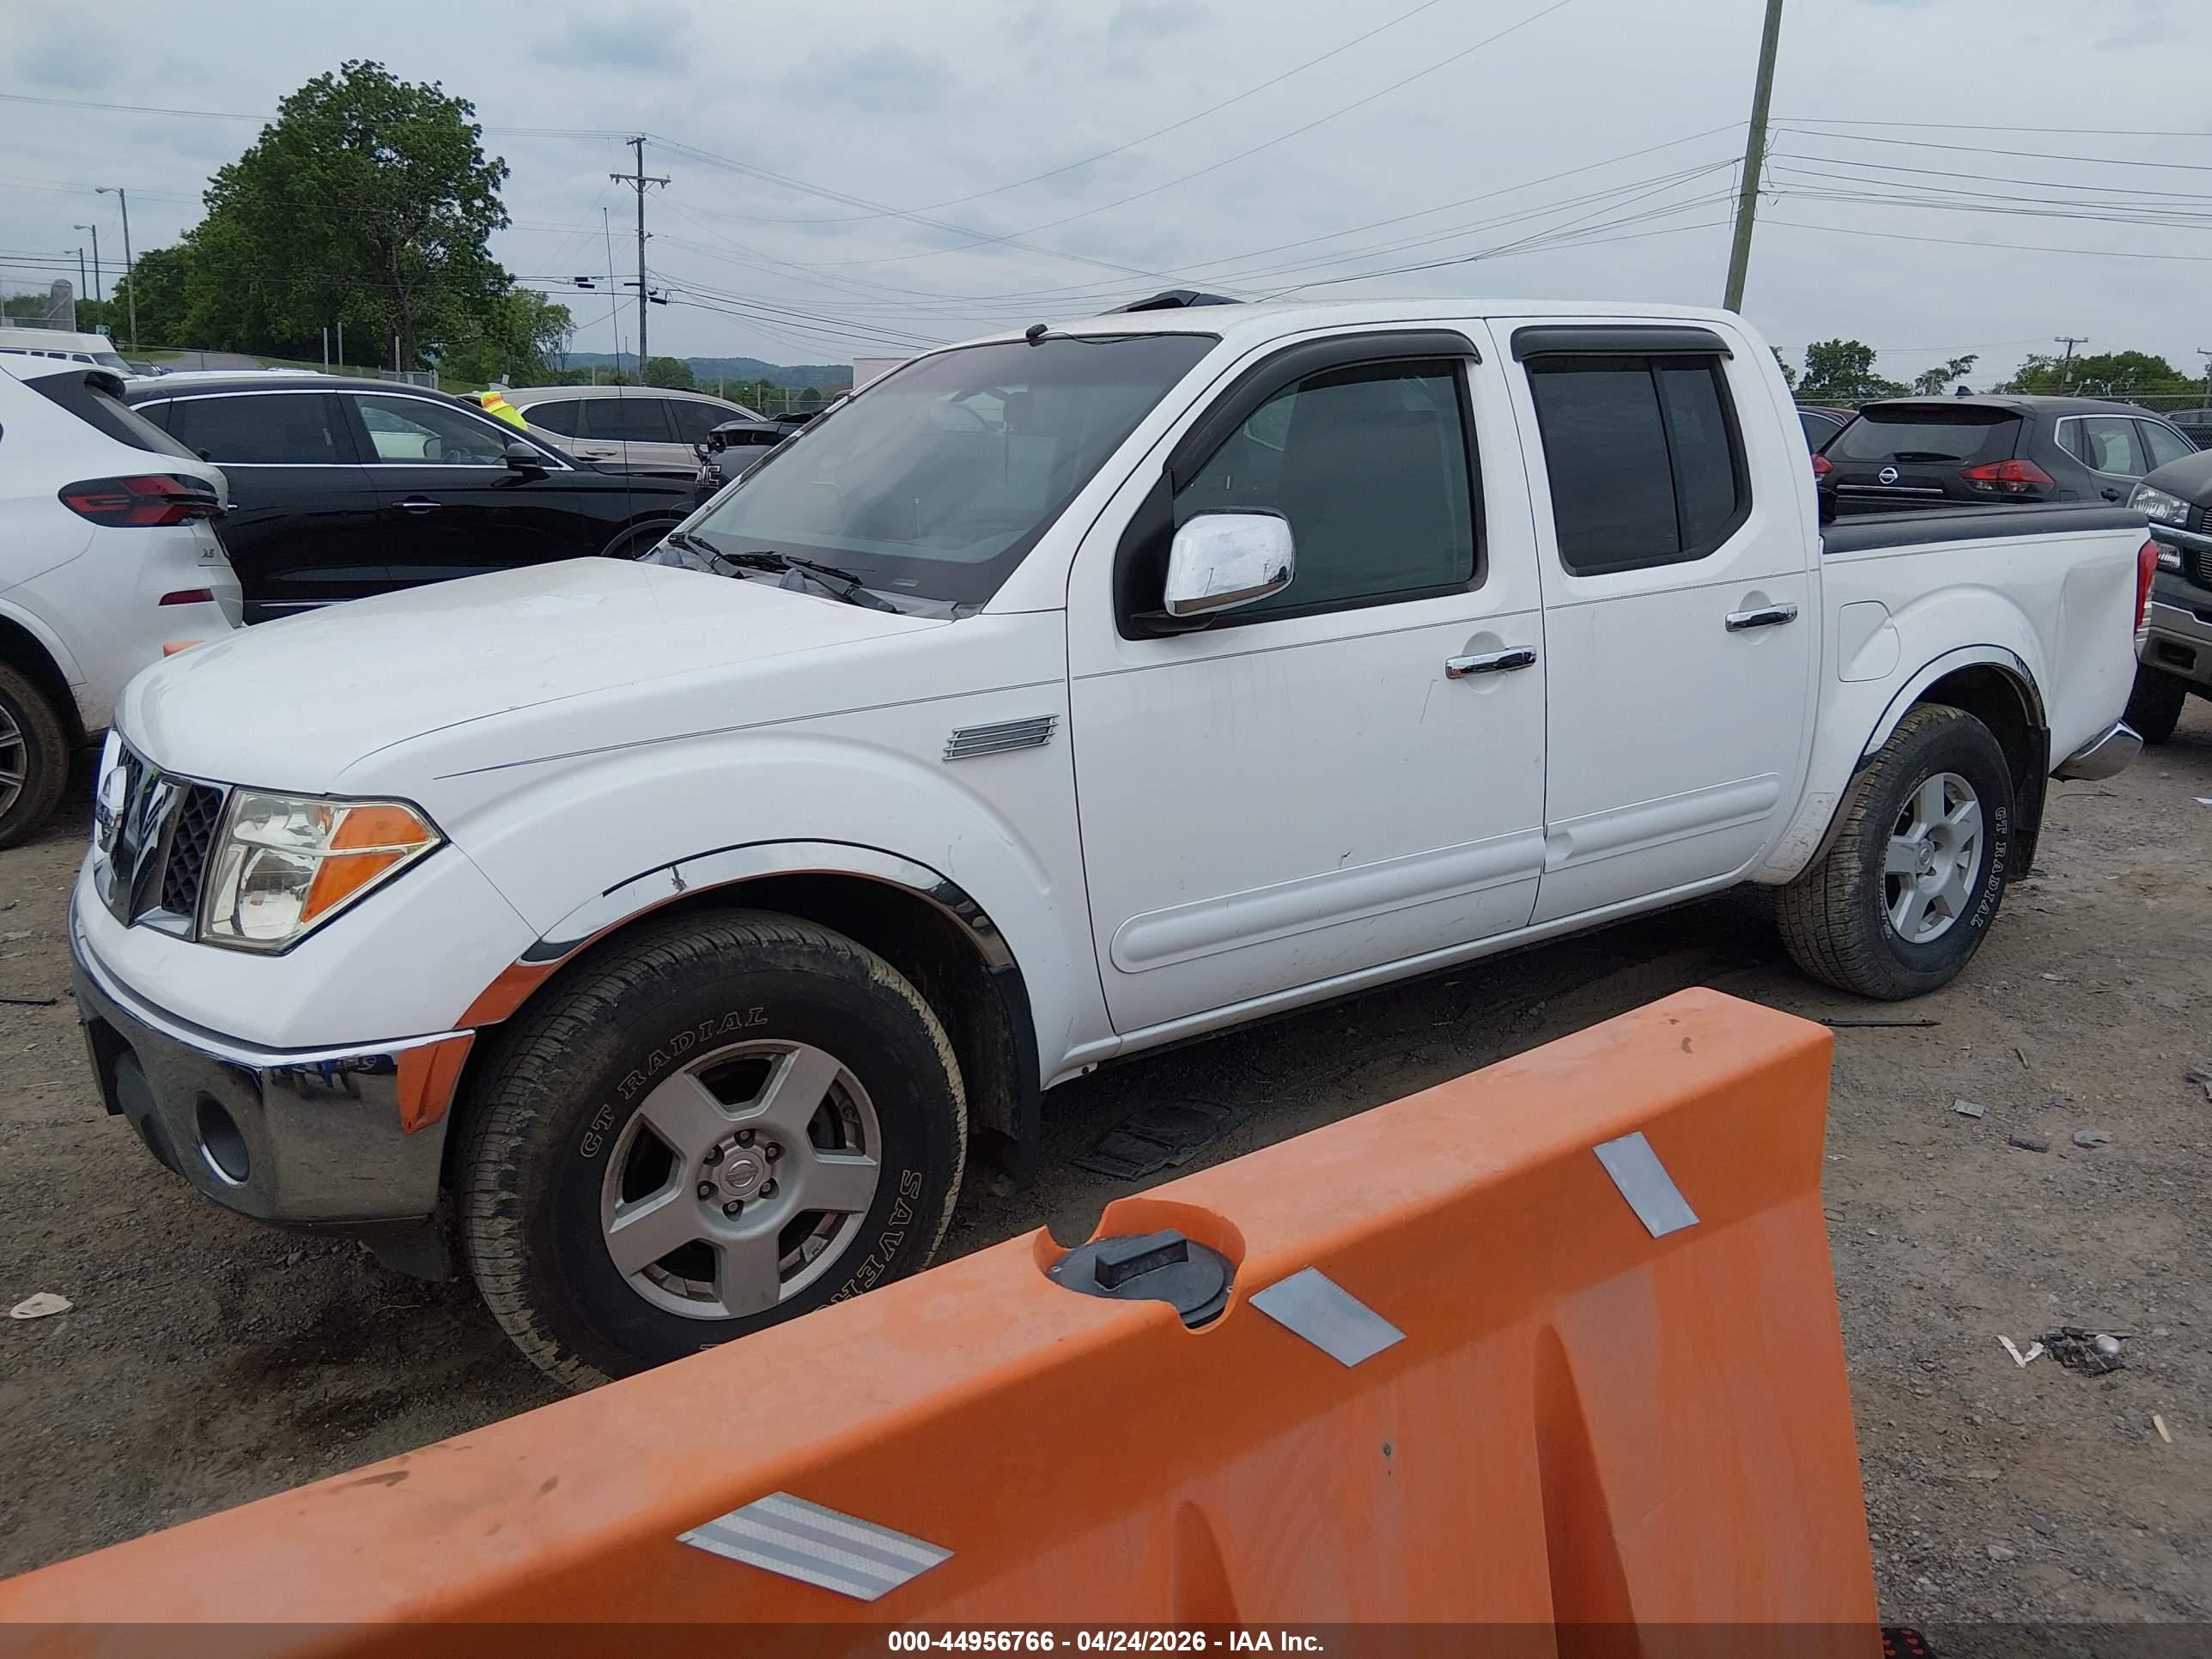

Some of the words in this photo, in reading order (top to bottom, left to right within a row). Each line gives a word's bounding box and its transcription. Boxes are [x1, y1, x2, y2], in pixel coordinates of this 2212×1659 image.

[1995, 806, 2008, 834] GT
[1970, 842, 2007, 928] RADIAL
[580, 1103, 615, 1158] GT
[617, 1006, 769, 1100] RADIAL
[815, 1170, 922, 1311] SAVER
